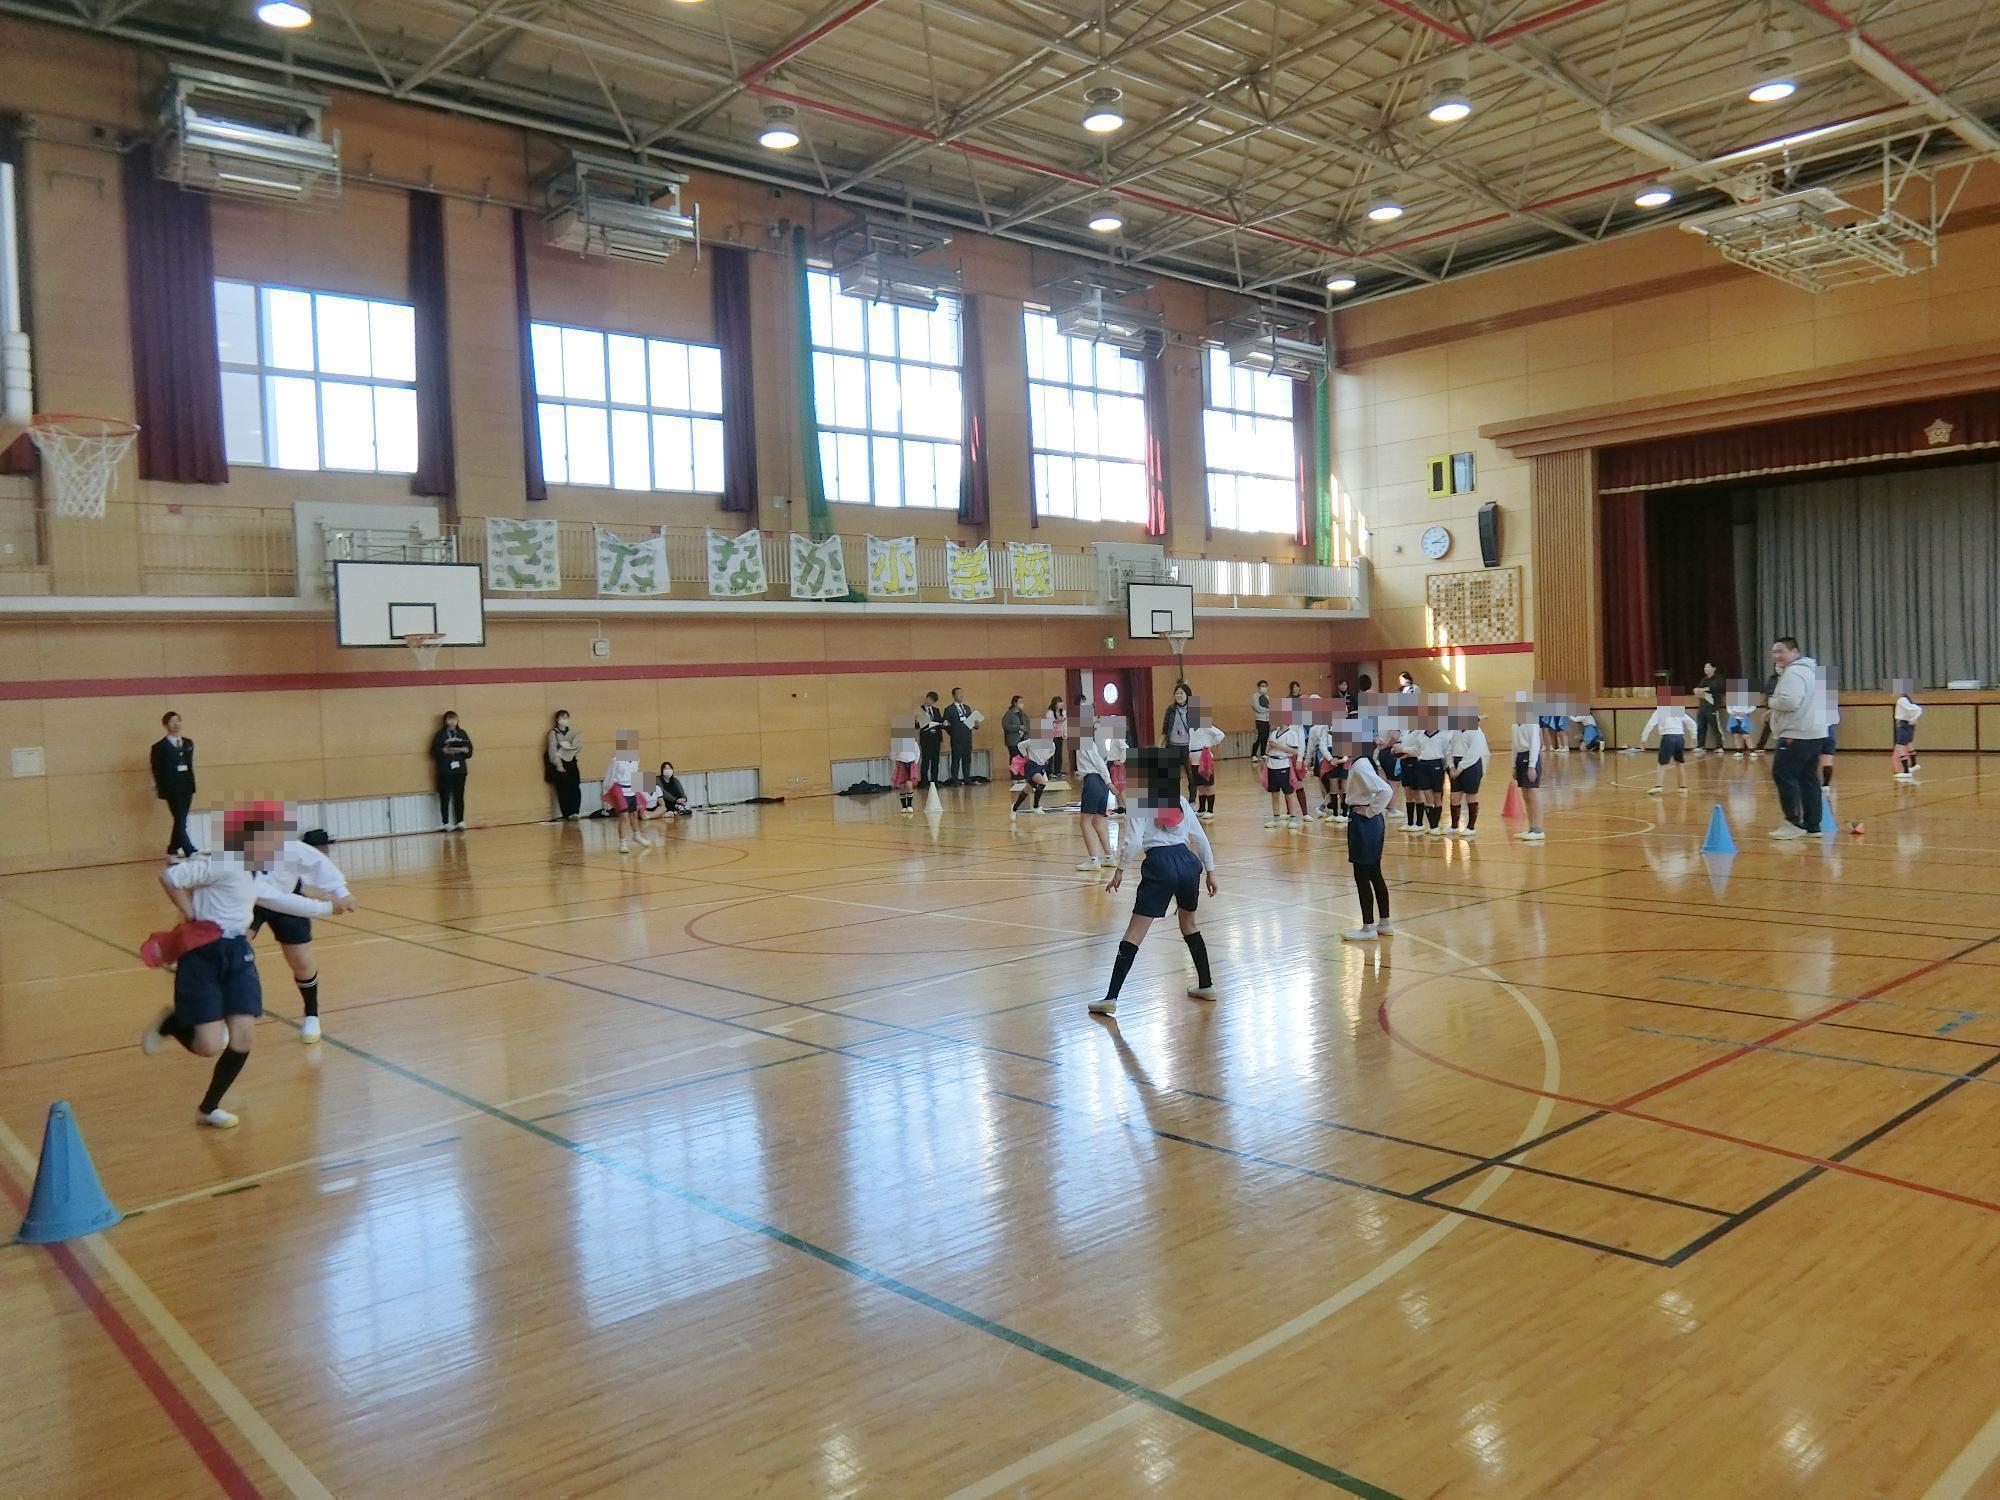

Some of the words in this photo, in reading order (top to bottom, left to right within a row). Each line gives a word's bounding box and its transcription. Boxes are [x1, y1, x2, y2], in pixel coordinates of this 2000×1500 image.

[501, 526, 543, 585] き
[607, 542, 653, 588] た
[712, 540, 757, 589] な
[797, 544, 841, 592] か
[872, 544, 915, 592] 小
[952, 549, 989, 597] 学
[1014, 544, 1053, 595] 校
